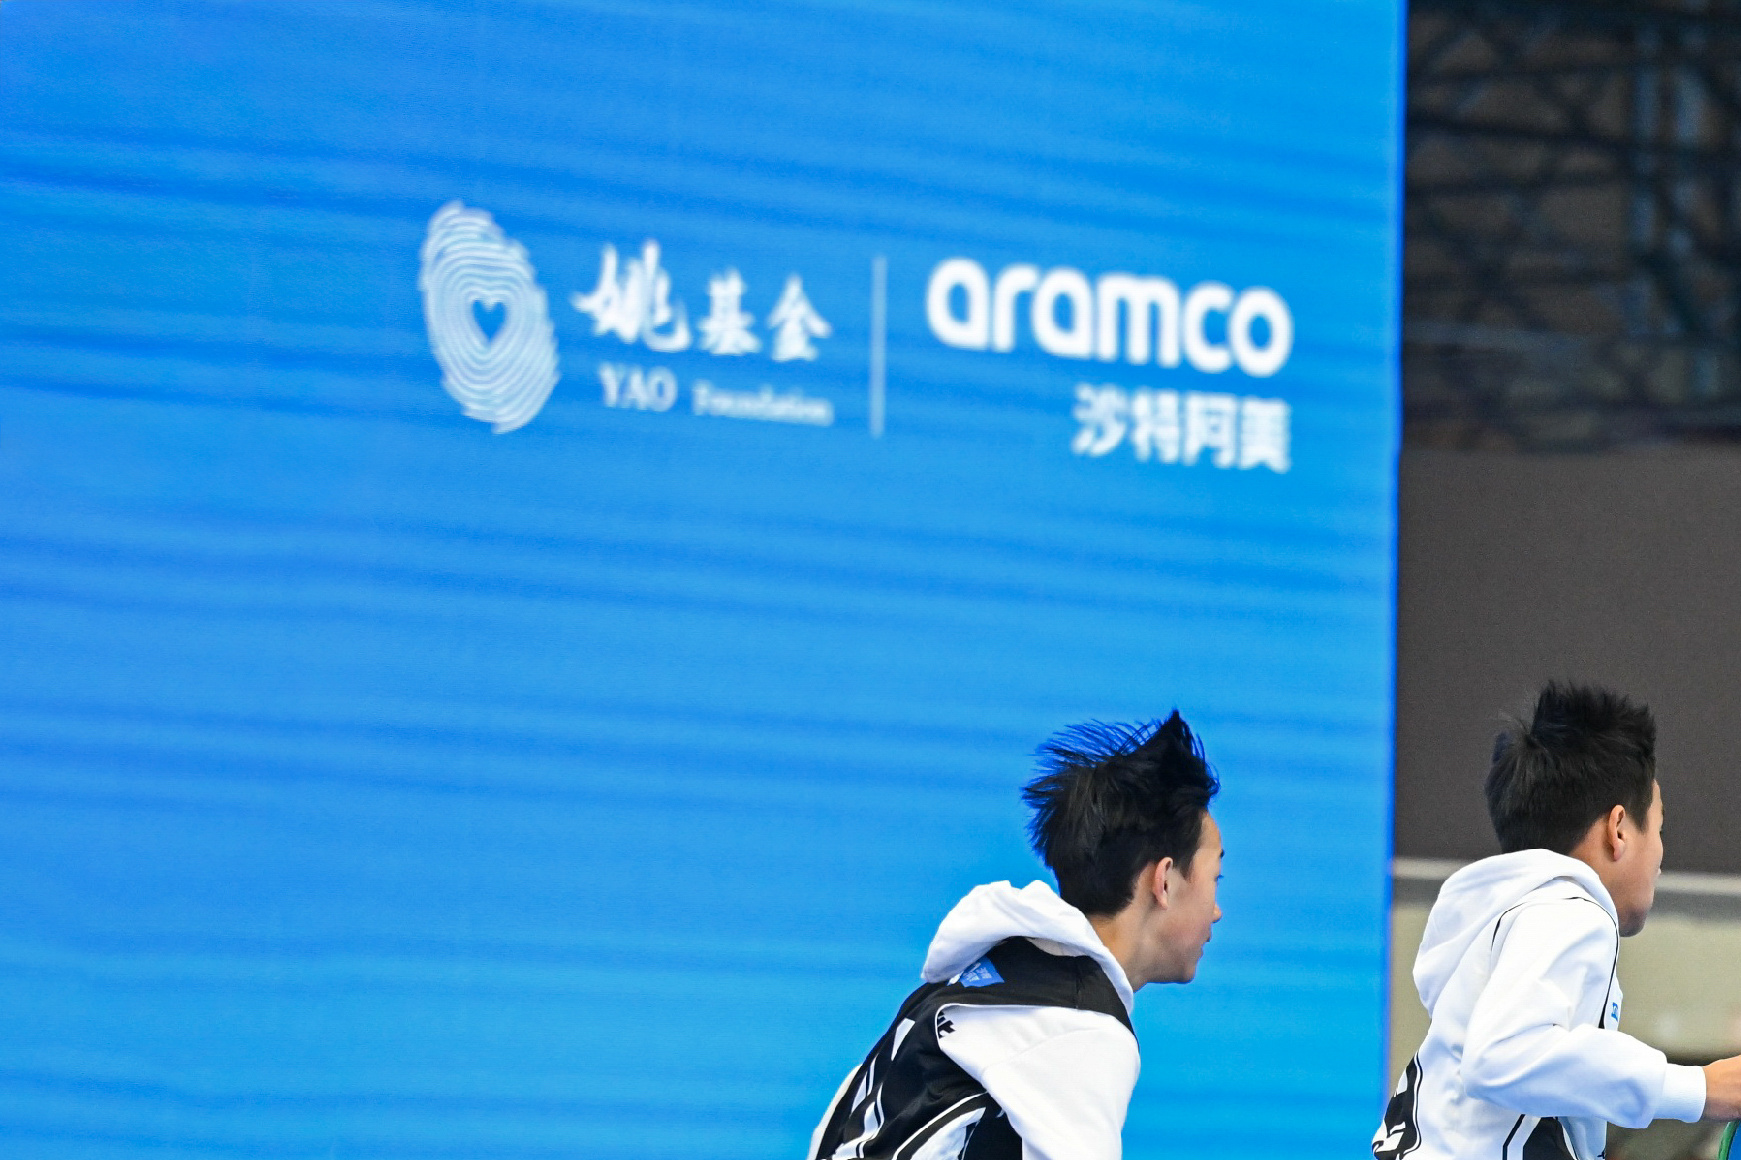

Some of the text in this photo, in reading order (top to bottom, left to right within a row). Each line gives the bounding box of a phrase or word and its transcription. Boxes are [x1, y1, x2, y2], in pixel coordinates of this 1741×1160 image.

[574, 240, 833, 363] 姚基金
[927, 257, 1294, 376] aramco
[599, 363, 677, 411] YAO
